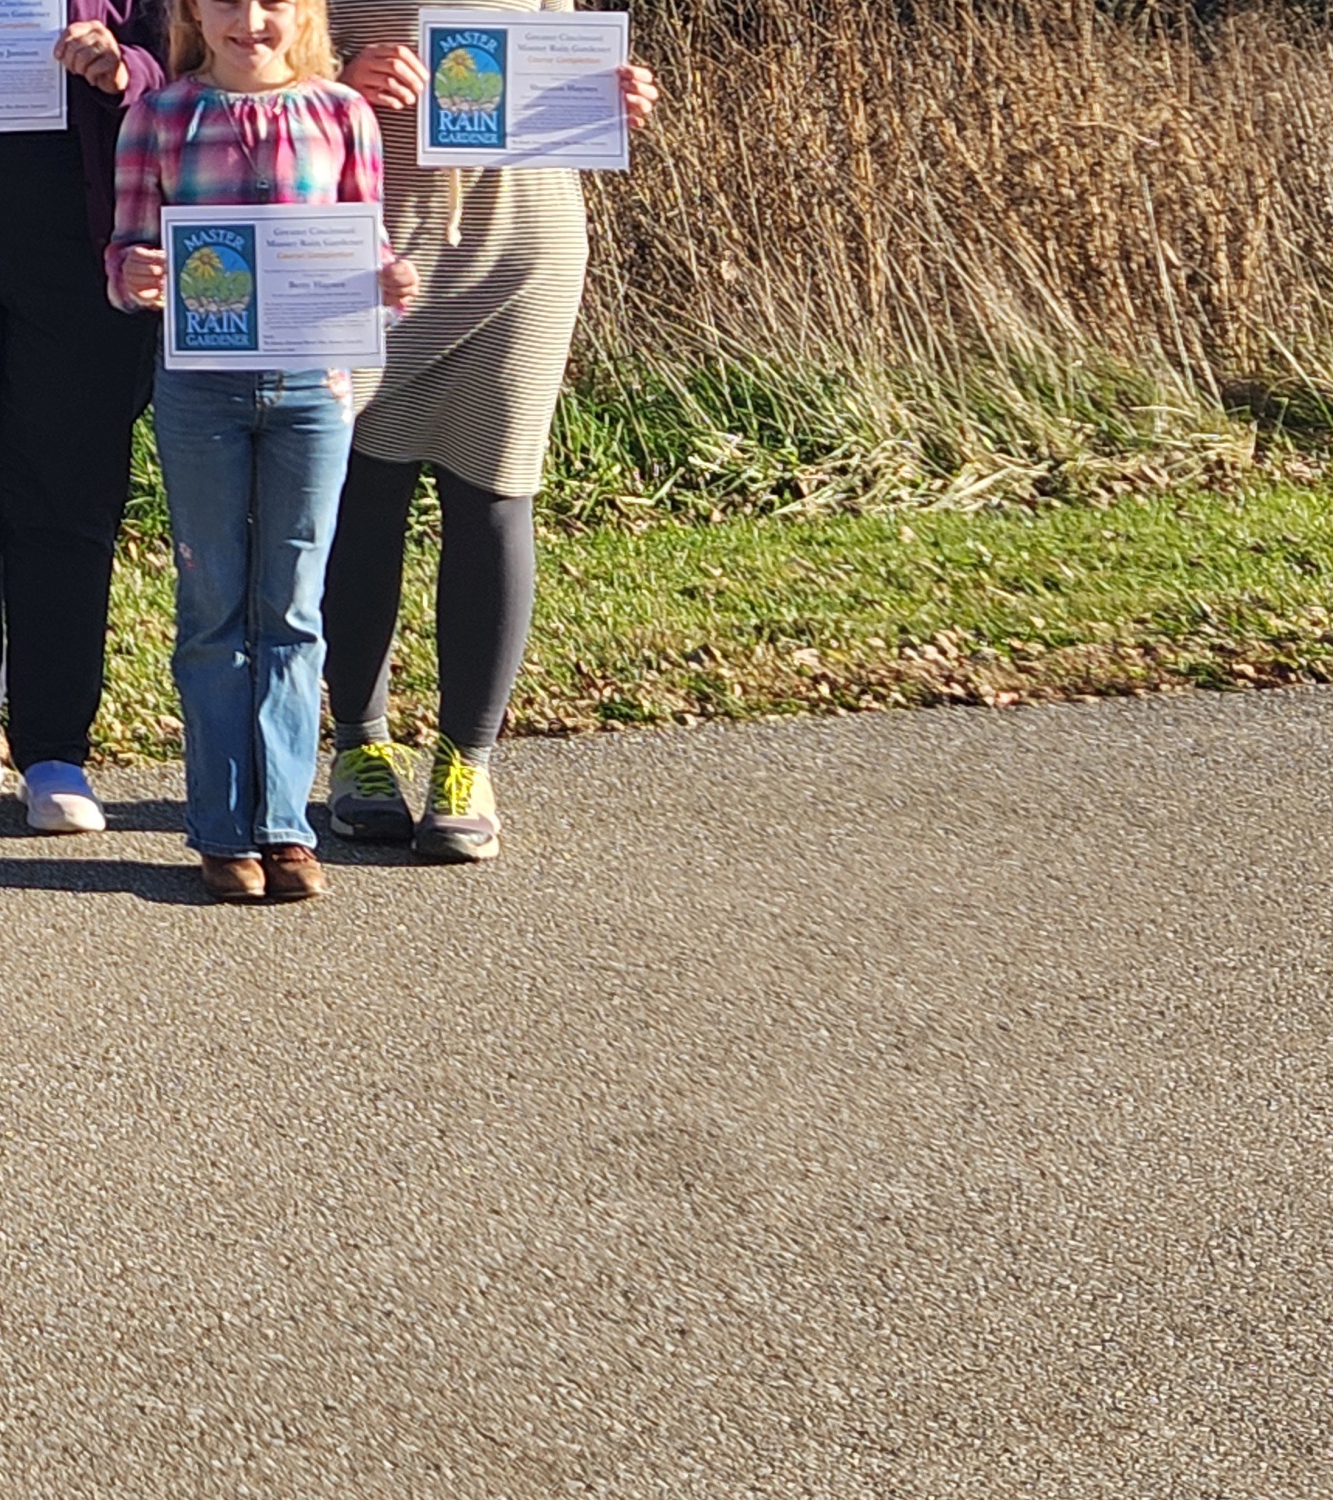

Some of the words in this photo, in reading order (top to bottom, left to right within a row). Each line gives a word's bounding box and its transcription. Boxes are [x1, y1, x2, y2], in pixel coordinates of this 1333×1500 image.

[441, 32, 498, 52] MASTER
[439, 111, 498, 132] RAIN
[438, 133, 498, 143] GARDENER
[184, 230, 245, 251] MASTER
[186, 311, 248, 334] RAIN
[186, 333, 249, 346] GARDENER
